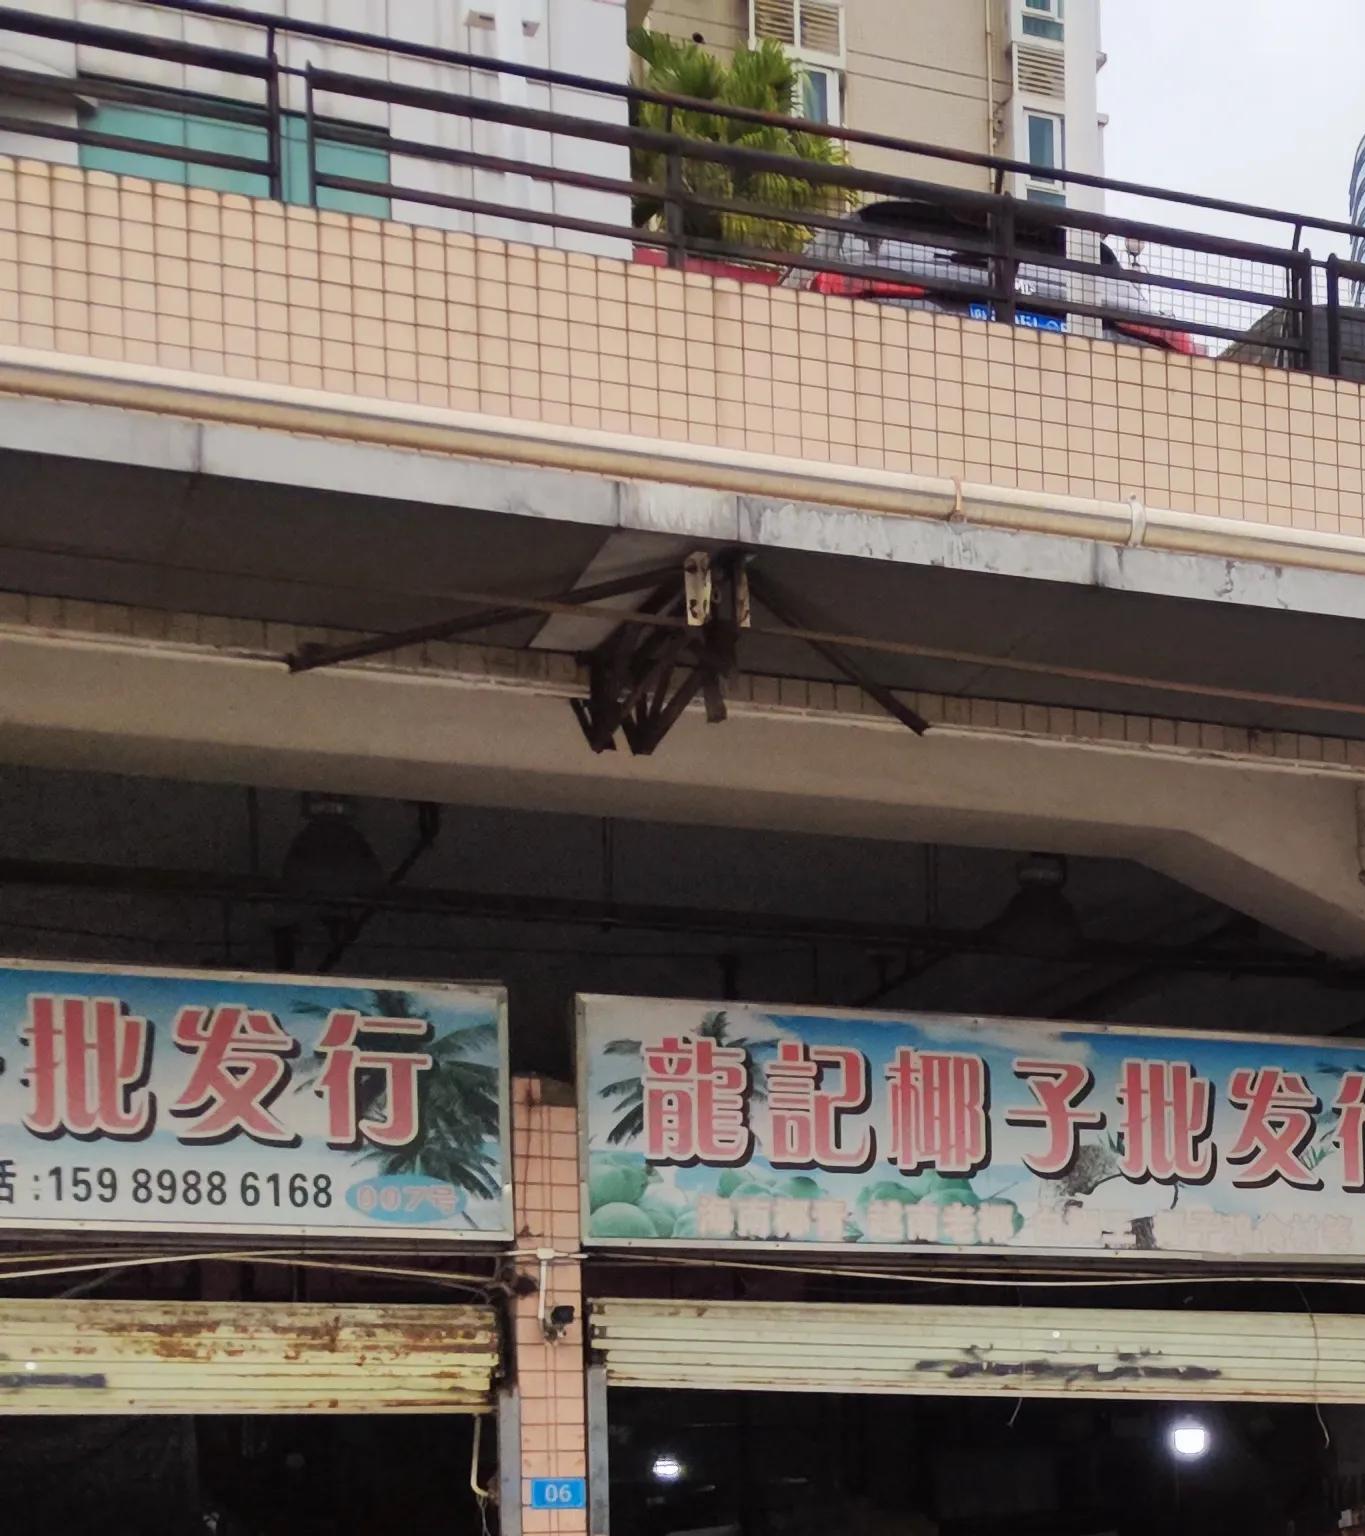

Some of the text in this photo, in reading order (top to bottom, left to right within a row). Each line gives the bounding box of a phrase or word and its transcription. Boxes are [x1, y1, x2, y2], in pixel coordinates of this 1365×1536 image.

[20, 990, 435, 1149] 批发行
[131, 1168, 228, 1206] 8988
[240, 1172, 333, 1209] 6168
[543, 1483, 573, 1504] 06
